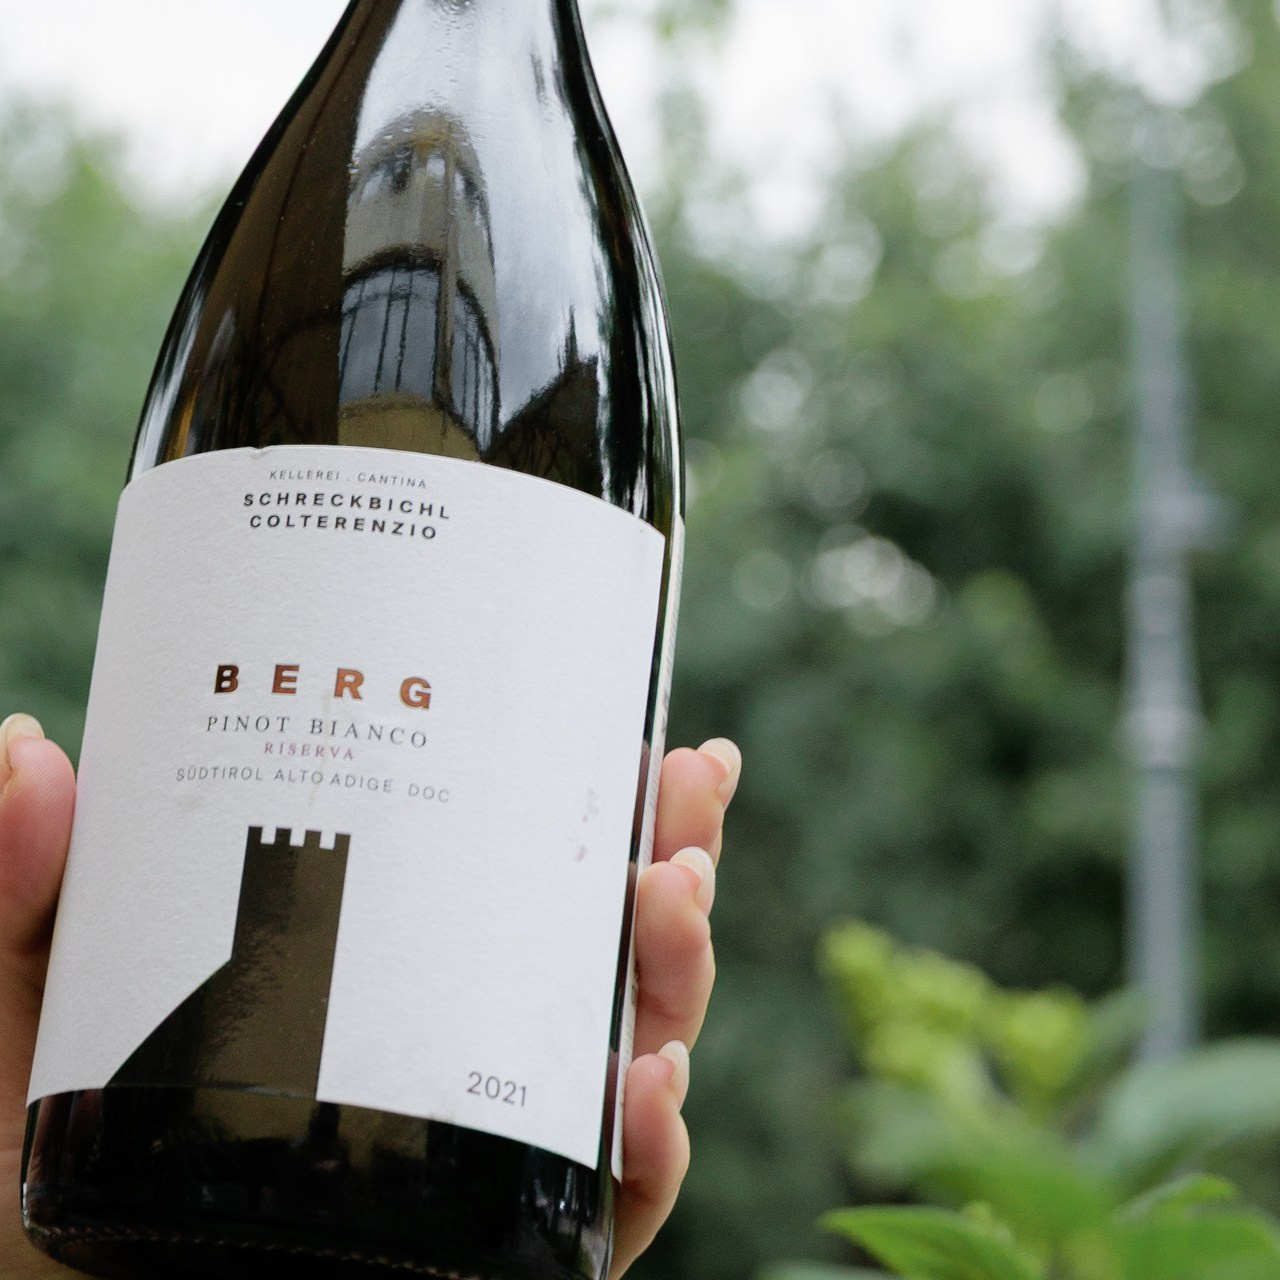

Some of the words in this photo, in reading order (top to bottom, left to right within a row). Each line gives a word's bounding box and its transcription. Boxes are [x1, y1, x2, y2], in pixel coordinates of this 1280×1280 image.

[269, 469, 340, 481] KELLEREI
[357, 472, 427, 489] CANTINA
[243, 492, 450, 520] SCHRECKBICHL
[249, 514, 437, 540] COLTERENZIO
[213, 664, 432, 710] BERG
[206, 715, 291, 733] PINOT
[310, 719, 428, 749] BIANCO
[263, 741, 355, 761] RISERVA
[175, 765, 264, 783] SÜDTIROL
[274, 768, 324, 785] ALTO
[329, 773, 394, 794] ADIGE
[407, 782, 451, 803] DOC
[466, 1070, 527, 1108] 2021
